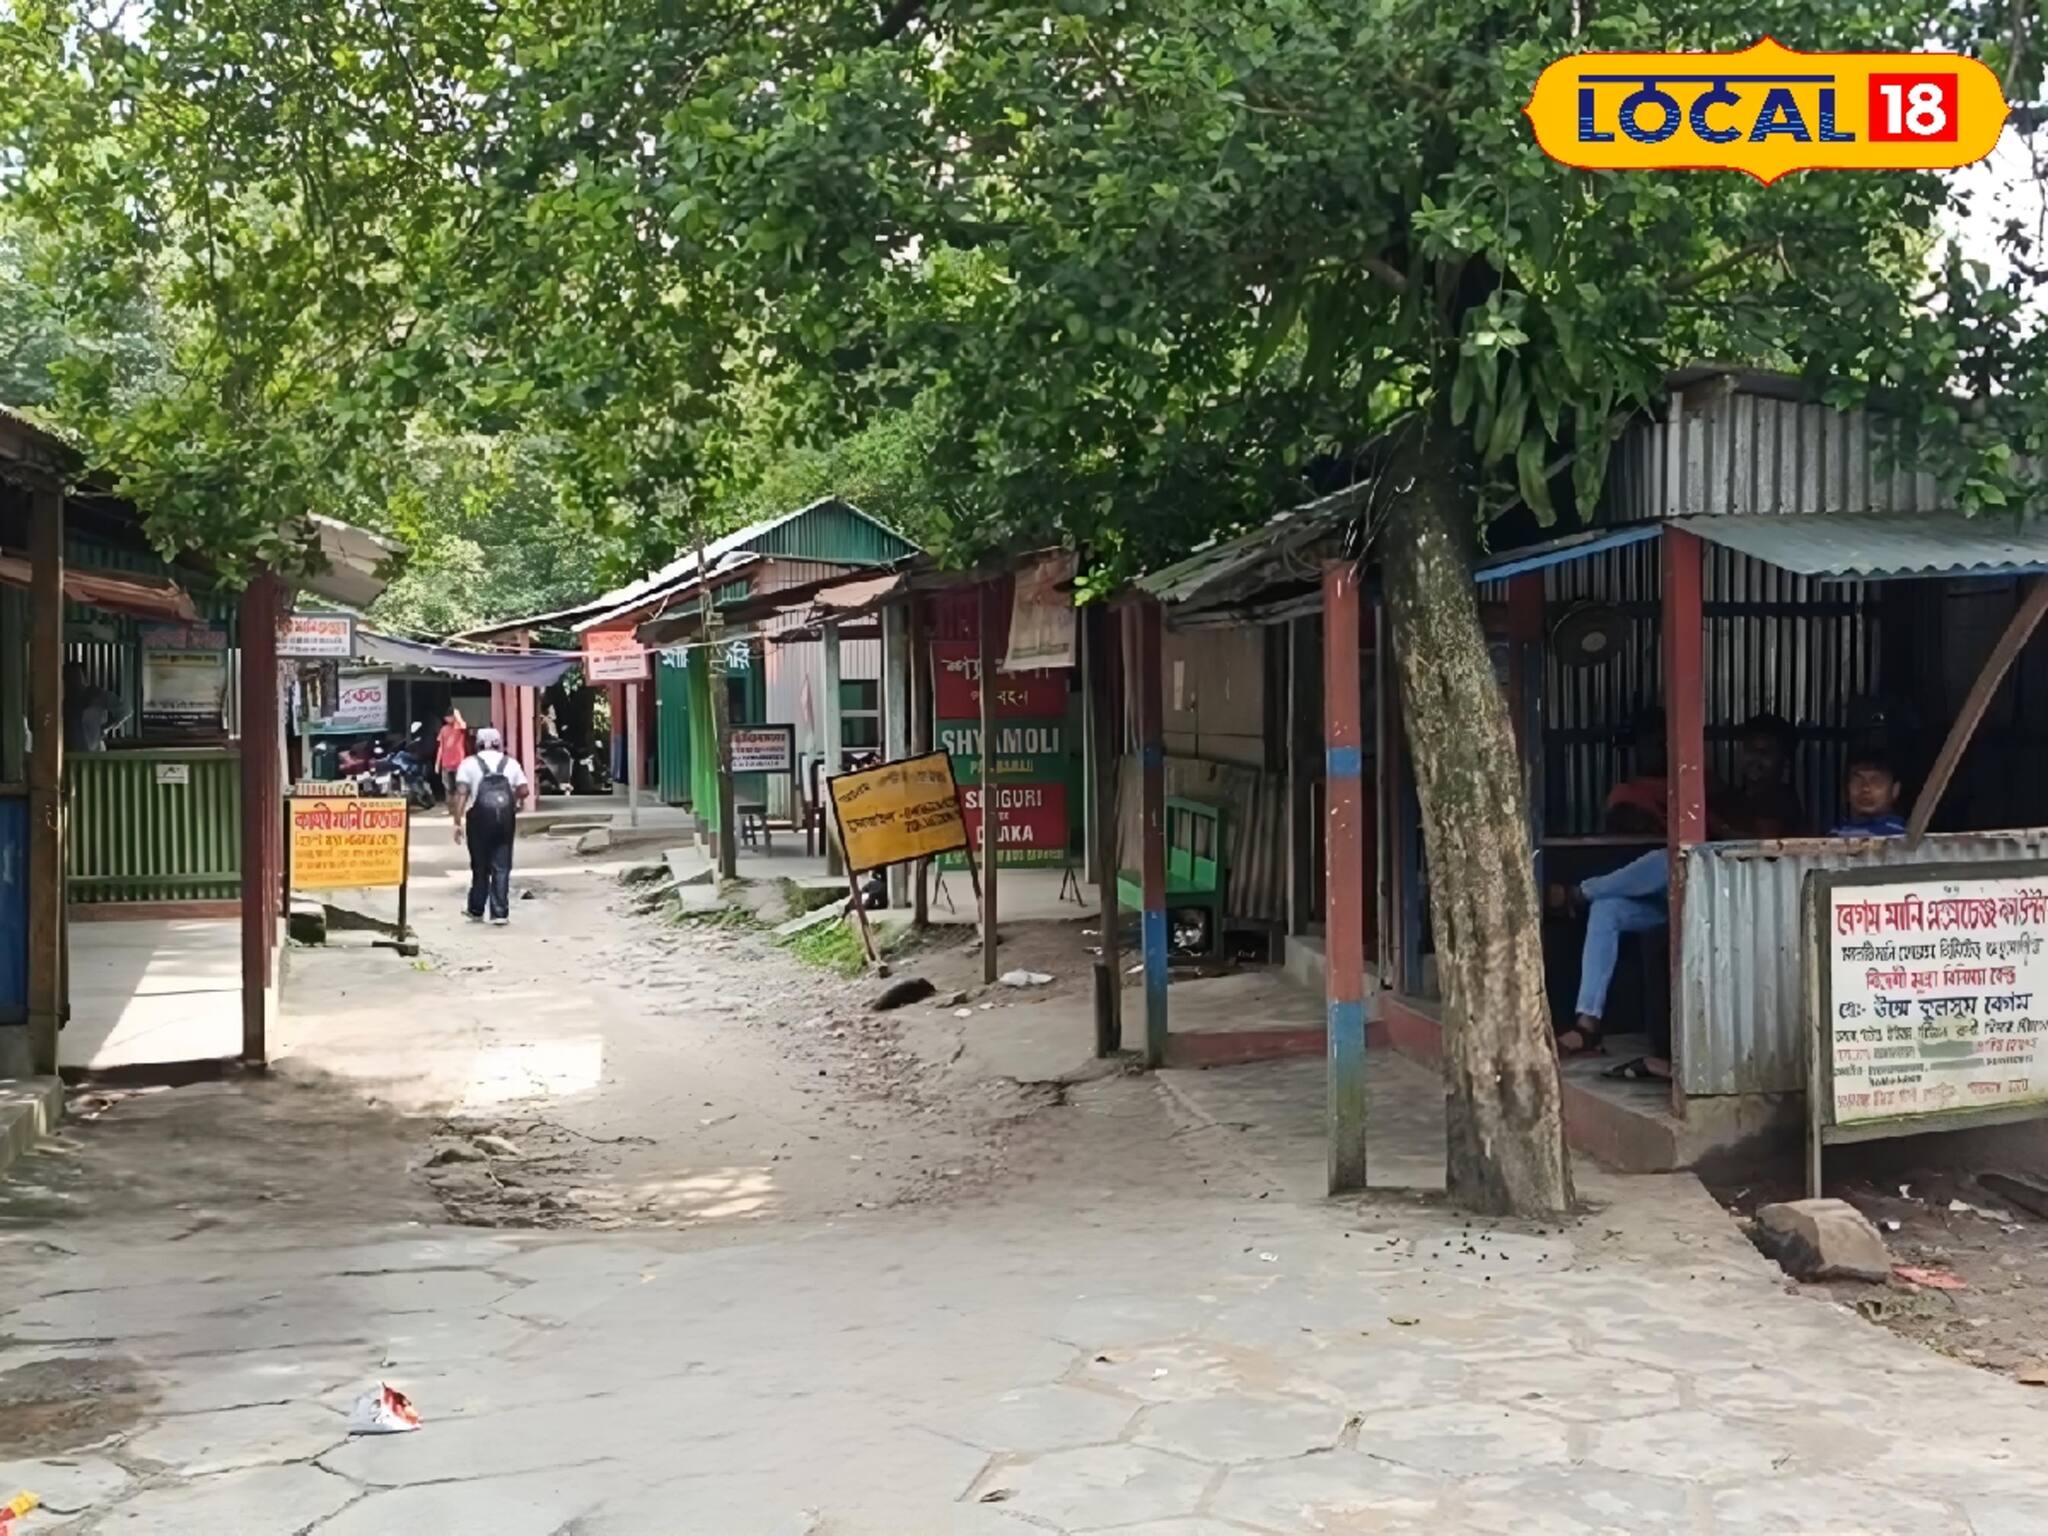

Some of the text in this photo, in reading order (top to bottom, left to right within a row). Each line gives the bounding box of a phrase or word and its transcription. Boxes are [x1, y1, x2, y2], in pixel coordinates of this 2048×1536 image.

[965, 789, 1042, 809] SIIGURI
[976, 825, 1034, 844] DAKA
[1835, 898, 1880, 935] বেগম
[1885, 893, 1924, 931] মানি
[1985, 992, 2033, 1015] বেগম
